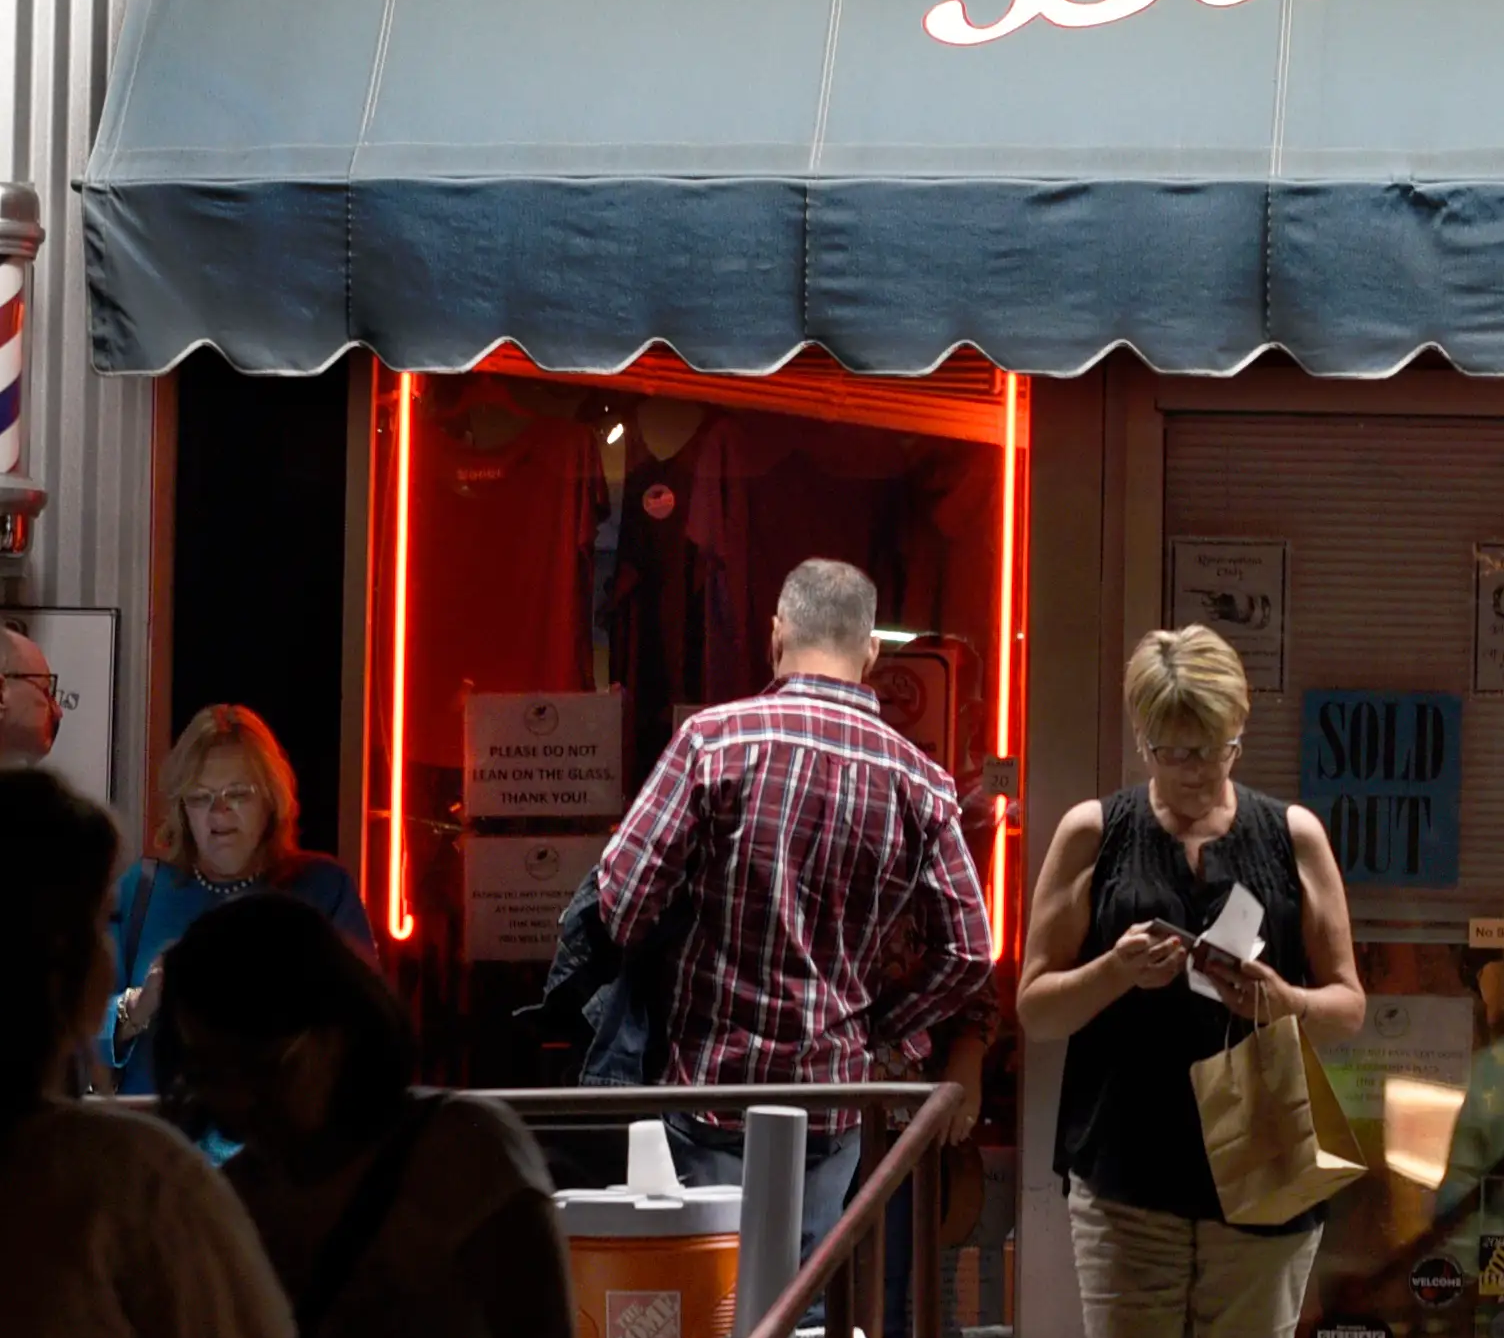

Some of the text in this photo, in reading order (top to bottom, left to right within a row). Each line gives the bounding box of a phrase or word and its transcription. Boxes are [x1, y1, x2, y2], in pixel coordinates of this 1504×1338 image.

[1316, 700, 1445, 783] SOLD
[489, 745, 598, 758] PLEASE DO NOT
[473, 769, 508, 782] LEAN
[512, 769, 533, 780] ON
[539, 769, 564, 780] THE
[501, 792, 587, 804] THANK YOU!
[1330, 794, 1433, 876] OUT
[1475, 927, 1493, 938] No
[1412, 1276, 1462, 1288] WELCOME
